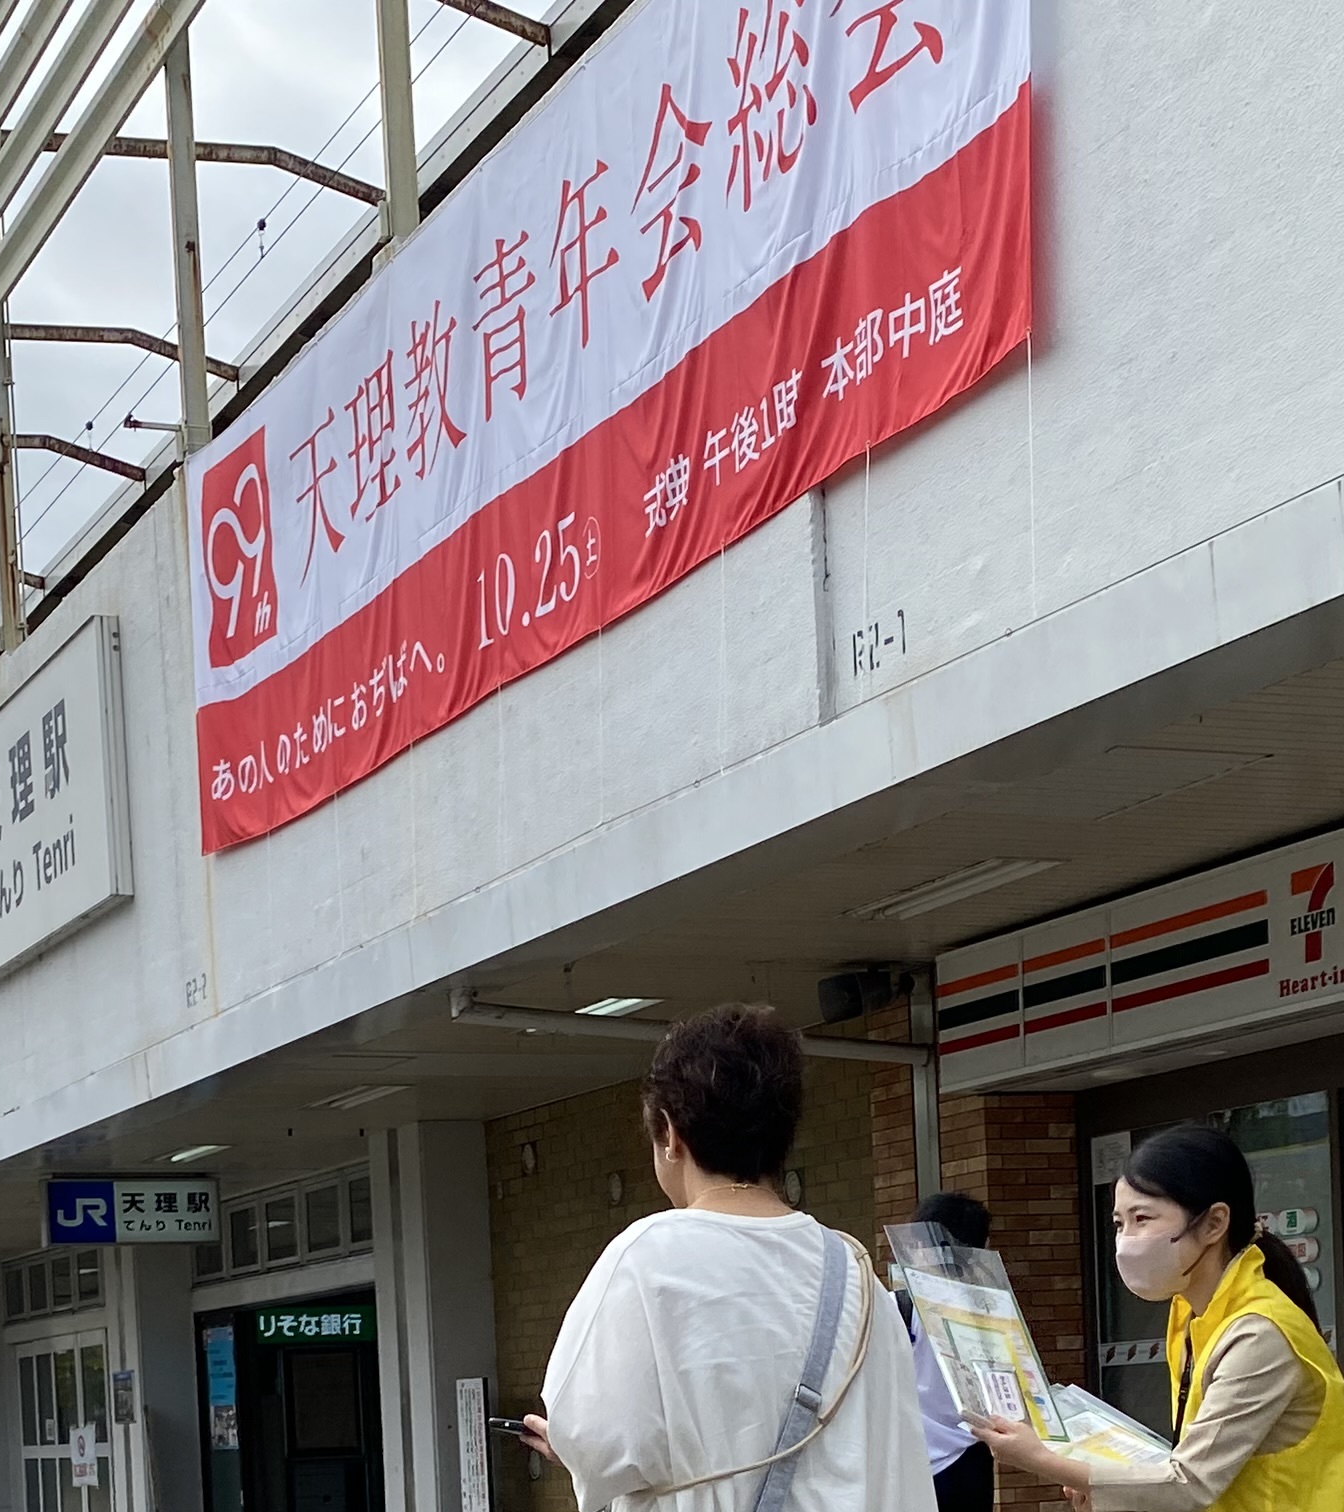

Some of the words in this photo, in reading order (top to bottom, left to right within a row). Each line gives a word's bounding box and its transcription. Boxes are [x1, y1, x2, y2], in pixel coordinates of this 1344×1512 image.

[821, 265, 964, 401] 本部中庭
[32, 813, 77, 892] Tenri
[56, 1197, 108, 1228] JR
[121, 1191, 211, 1214] 天理駅
[122, 1219, 166, 1232] てんり
[174, 1218, 212, 1232] Tenri
[258, 1312, 362, 1338] りそな銀行
